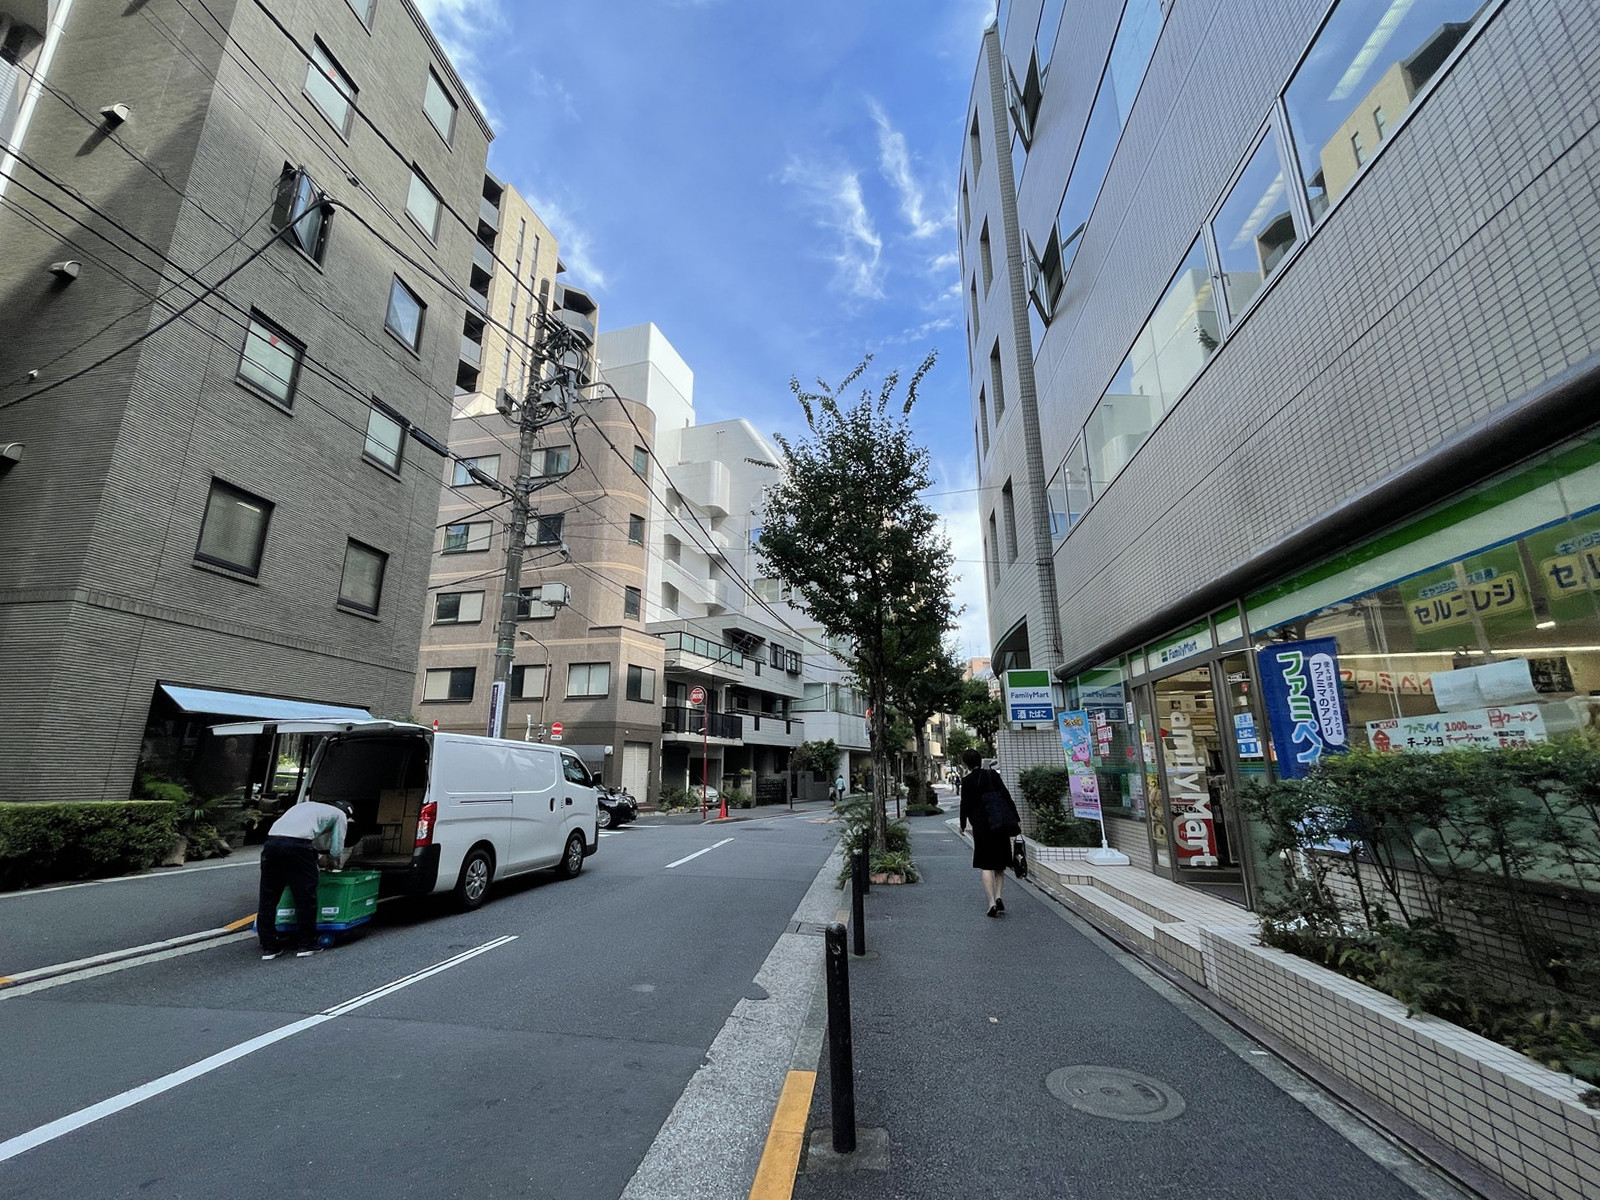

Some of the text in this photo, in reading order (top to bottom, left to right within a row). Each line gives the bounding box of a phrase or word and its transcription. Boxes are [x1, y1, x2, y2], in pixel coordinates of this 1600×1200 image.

[1419, 568, 1495, 597] キャッシュス専用
[1168, 640, 1198, 660] FamilyMart
[1010, 691, 1049, 700] FamilyMart
[1276, 651, 1323, 764] ファミペイ
[1312, 662, 1334, 737] ファミマのアプリ
[1029, 710, 1047, 718] たばこ
